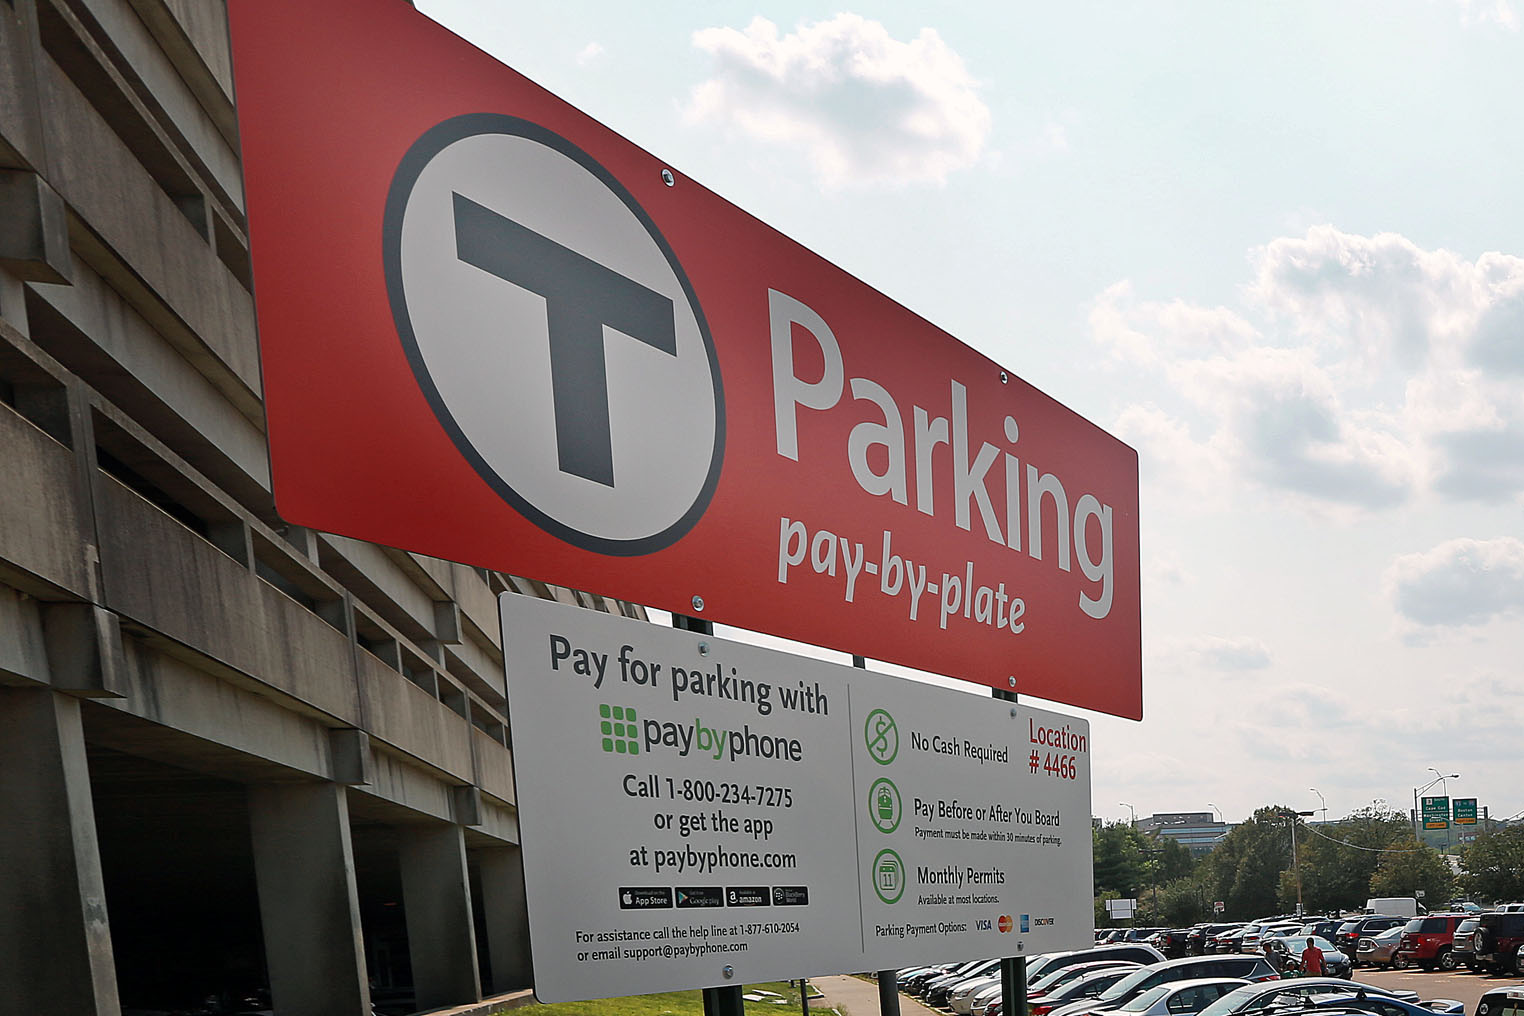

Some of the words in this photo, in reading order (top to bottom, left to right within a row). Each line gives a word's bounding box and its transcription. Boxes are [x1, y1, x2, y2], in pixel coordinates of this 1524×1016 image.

[452, 191, 677, 488] T
[768, 287, 1114, 619] Parking
[778, 517, 1026, 634] pay-by-plate
[550, 634, 608, 689] Pay
[618, 645, 661, 686] for
[671, 663, 772, 716] parking
[778, 681, 829, 715] with
[643, 718, 802, 762] paybyphone
[911, 731, 929, 751] No
[932, 735, 960, 756] Cash
[964, 740, 1009, 764] Required
[1029, 718, 1087, 753] Location
[1029, 749, 1040, 774] #
[1043, 752, 1077, 780] 4466
[622, 774, 660, 798] Call
[666, 777, 793, 808] 1-800-234-7275
[654, 812, 673, 830] or
[679, 812, 707, 837] get
[711, 810, 739, 832] the
[744, 817, 773, 840] app
[914, 798, 935, 822] Pay
[938, 800, 973, 820] Before
[975, 806, 986, 821] or
[989, 804, 1013, 823] After
[1014, 807, 1033, 824] You
[1035, 810, 1060, 827] Board
[914, 826, 944, 841] Payment
[944, 829, 962, 840] must
[962, 829, 970, 840] be
[970, 830, 988, 841] made
[988, 831, 1006, 842] within
[1006, 832, 1014, 842] 30
[1014, 832, 1036, 844] minutes
[1036, 833, 1042, 844] of
[1042, 834, 1062, 848] parking.
[629, 846, 649, 866] at
[654, 844, 797, 873] paybyphone.com
[917, 865, 964, 889] Monthly
[966, 866, 1005, 885] Permits
[635, 897, 649, 906] App
[650, 896, 668, 905] Store
[917, 893, 947, 905] Available
[947, 895, 955, 905] at
[955, 894, 971, 904] most
[972, 893, 1000, 904] locations.
[575, 930, 594, 943] For
[597, 929, 651, 942] assistance
[653, 927, 670, 940] call
[672, 926, 687, 938] the
[689, 925, 709, 940] help
[711, 925, 728, 937] line
[729, 925, 738, 936] at
[739, 922, 800, 936] 1-877-610-2054
[875, 923, 905, 939] Parking
[906, 922, 937, 938] Payment
[938, 921, 967, 935] Options:
[975, 919, 992, 931] VISA
[577, 950, 588, 961] or
[592, 947, 621, 960] email
[623, 941, 748, 961] support@paybyphone.com
